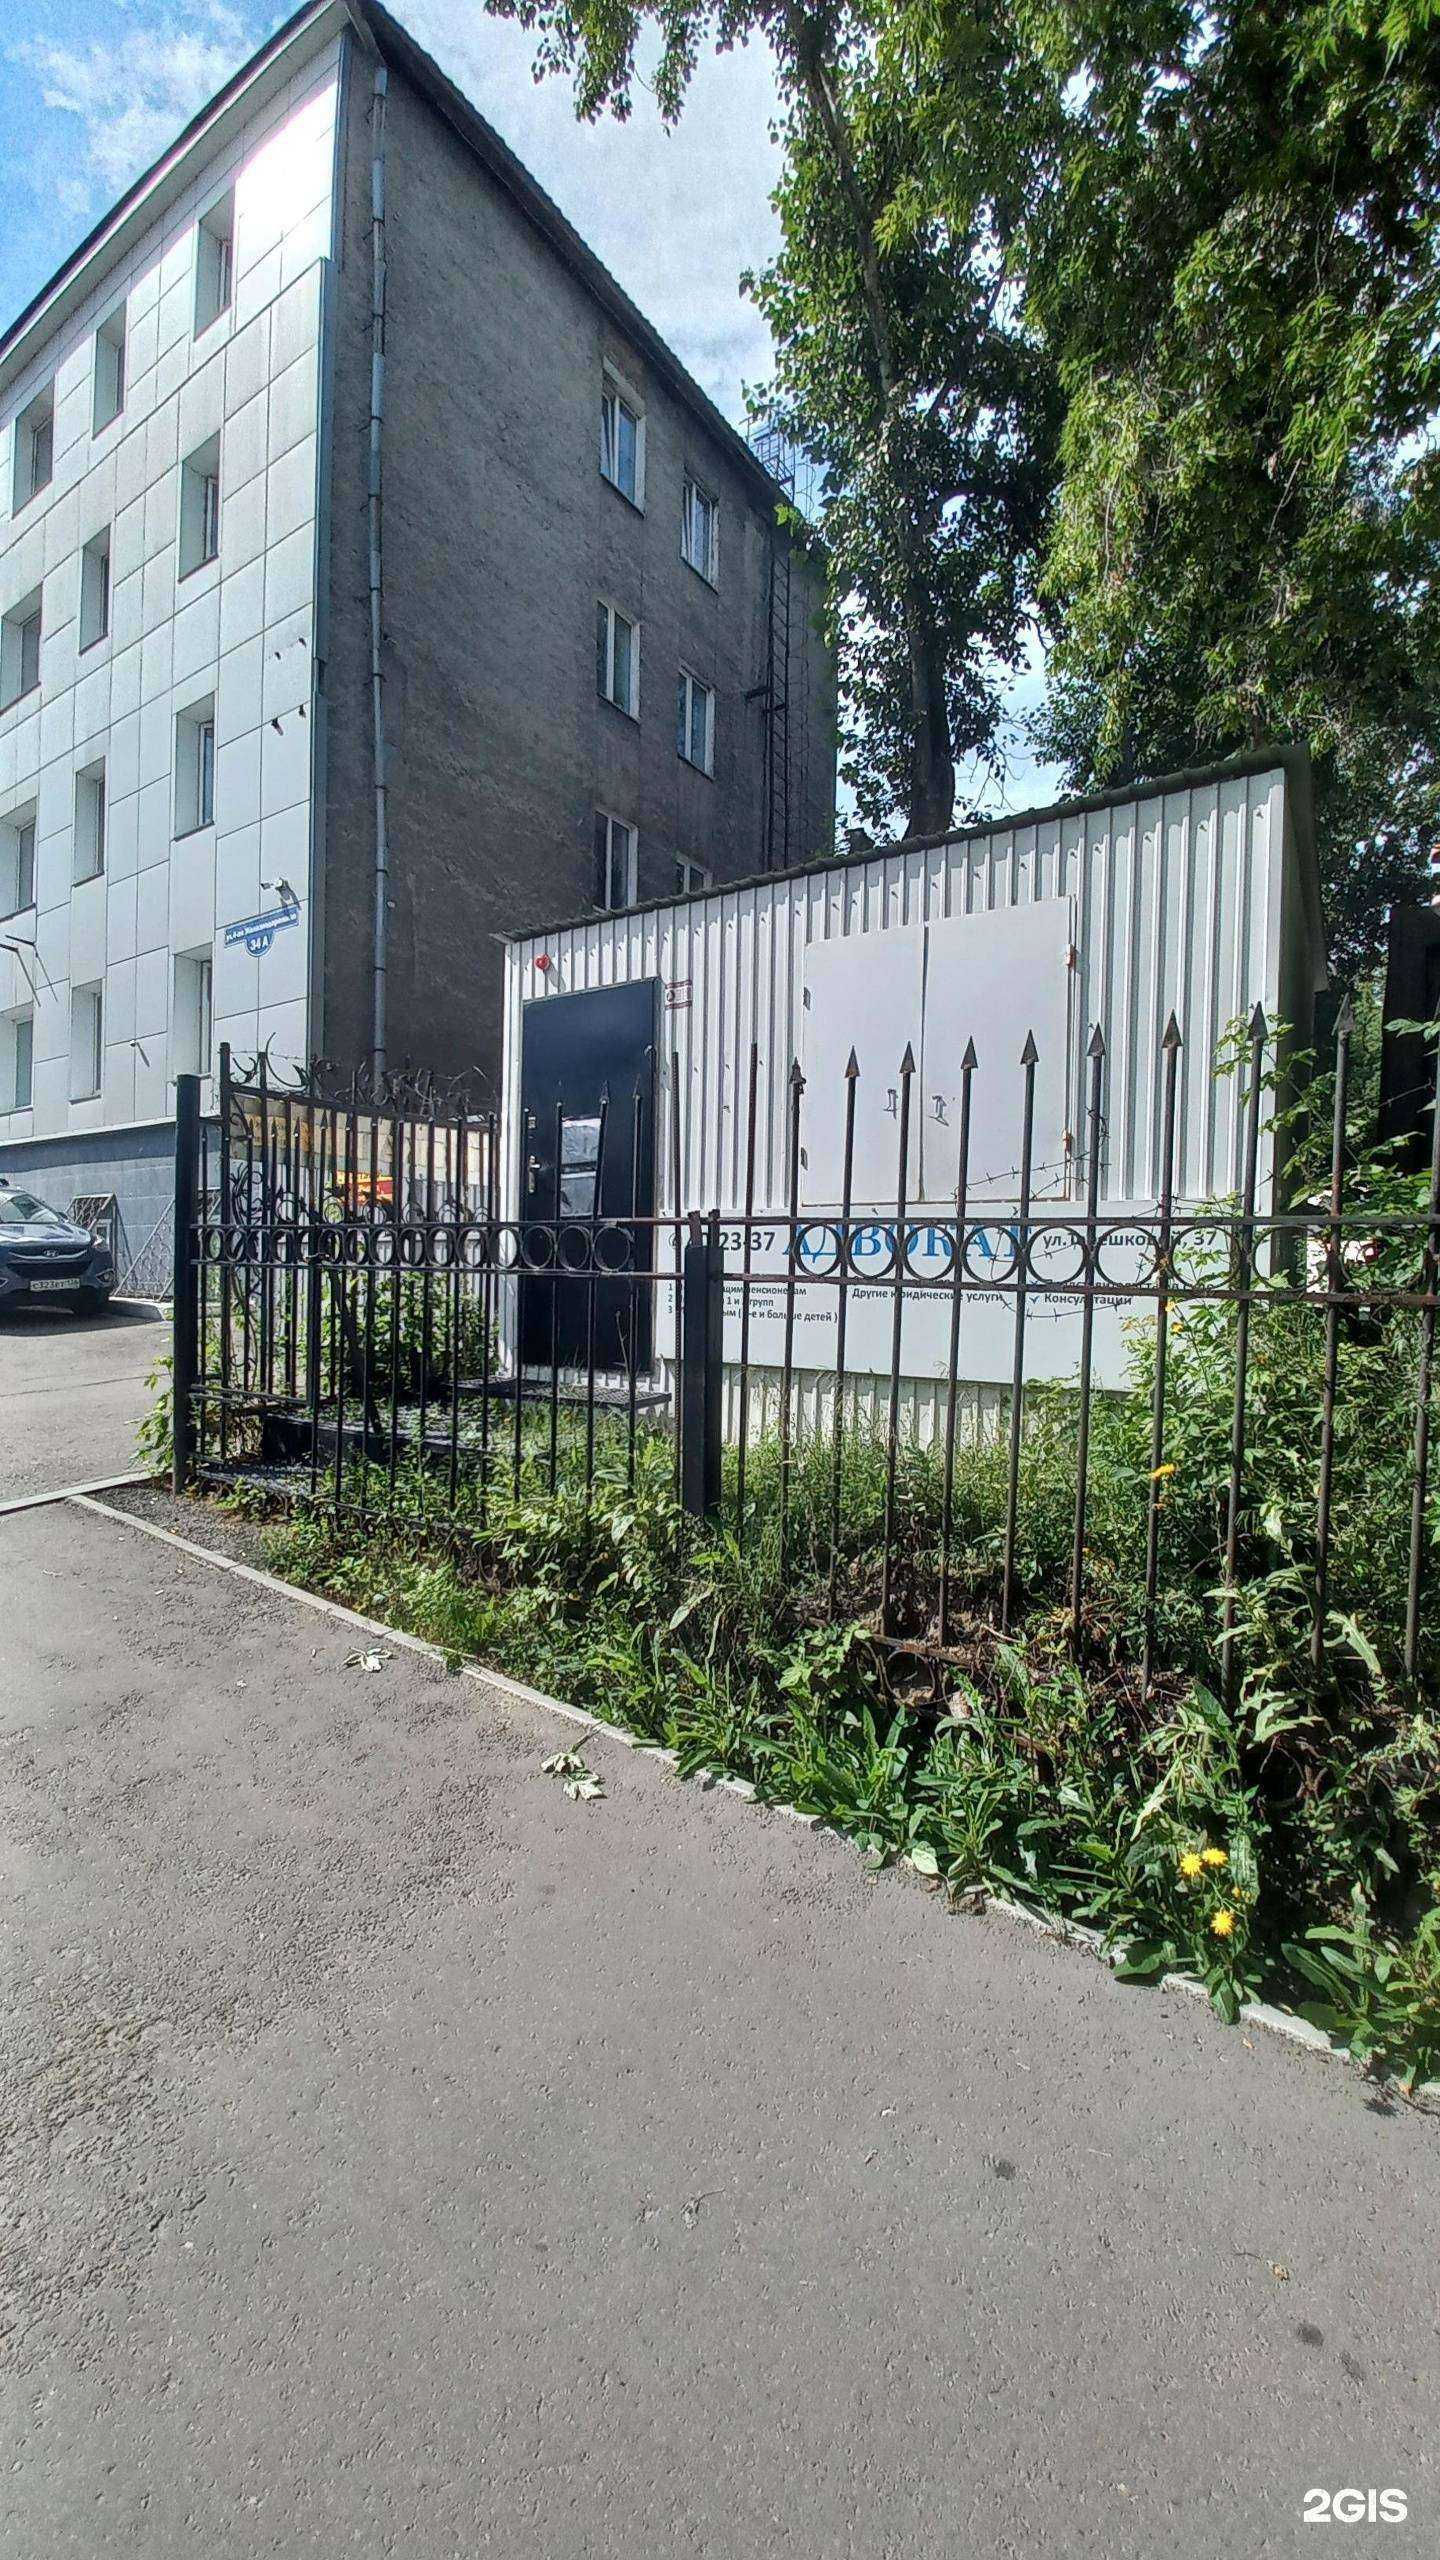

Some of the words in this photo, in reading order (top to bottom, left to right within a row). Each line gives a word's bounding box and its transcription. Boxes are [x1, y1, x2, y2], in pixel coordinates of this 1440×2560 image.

[249, 937, 261, 951] 34
[852, 1288, 888, 1299] Другие
[1044, 1293, 1132, 1306] Консултации
[804, 1312, 832, 1322] детей
